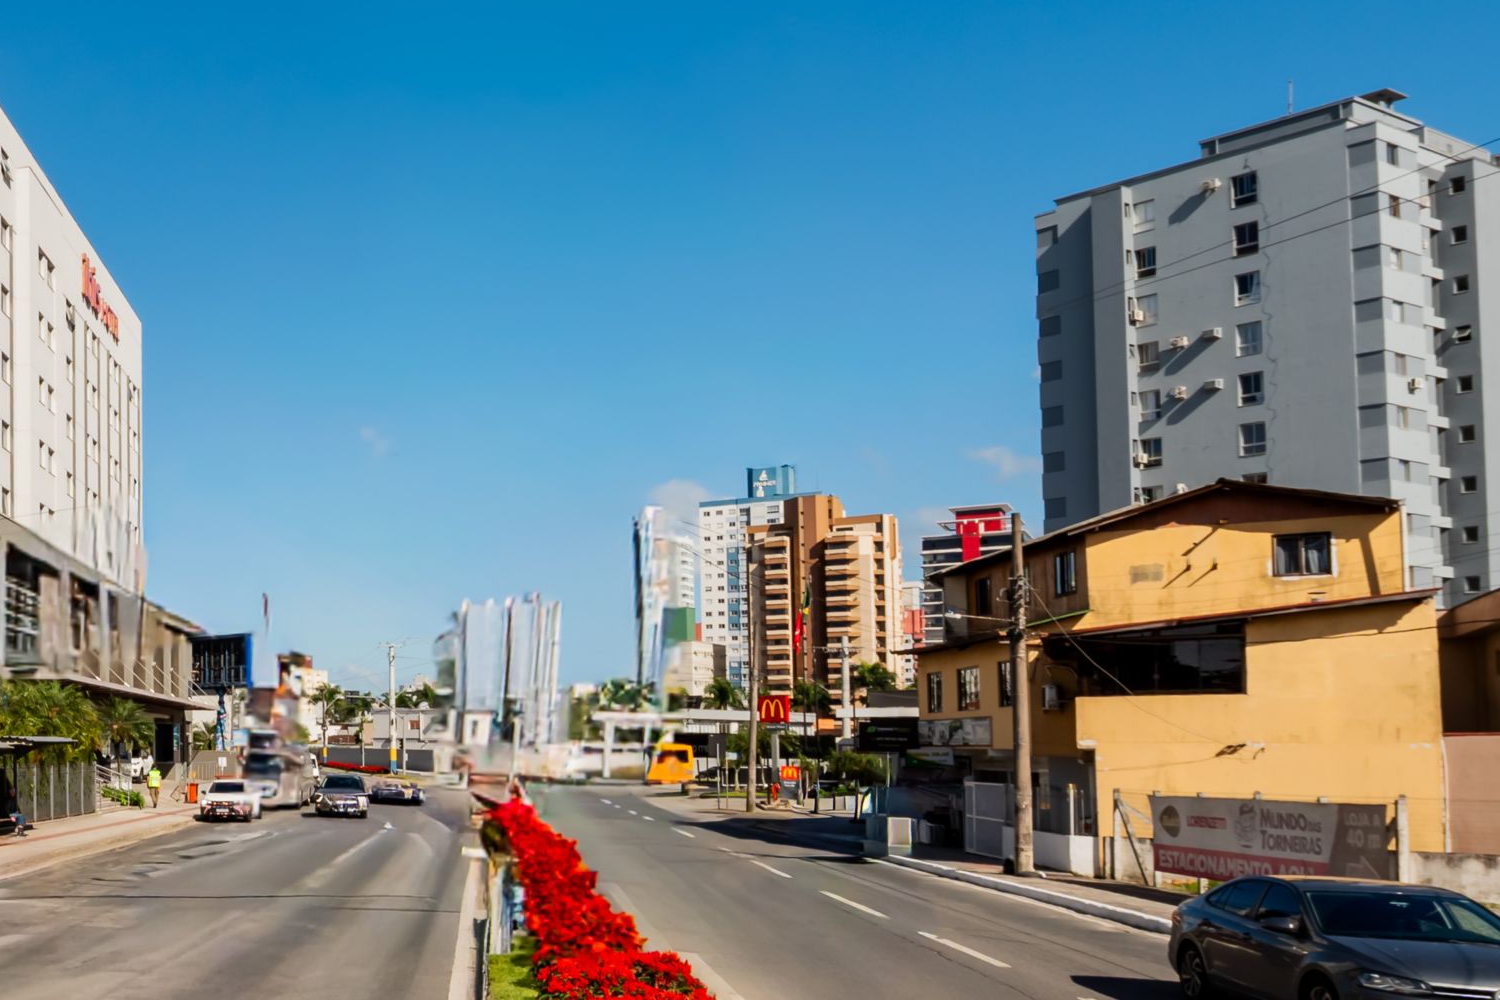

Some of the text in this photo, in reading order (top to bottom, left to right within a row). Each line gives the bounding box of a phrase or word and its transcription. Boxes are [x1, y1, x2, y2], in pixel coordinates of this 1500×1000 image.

[1260, 808, 1307, 832] MUNDO
[1344, 811, 1381, 827] LOJA A
[1260, 830, 1323, 855] TORNEIRAS
[1346, 829, 1365, 849] 40
[1158, 849, 1272, 876] ESTACIONAMENTO
